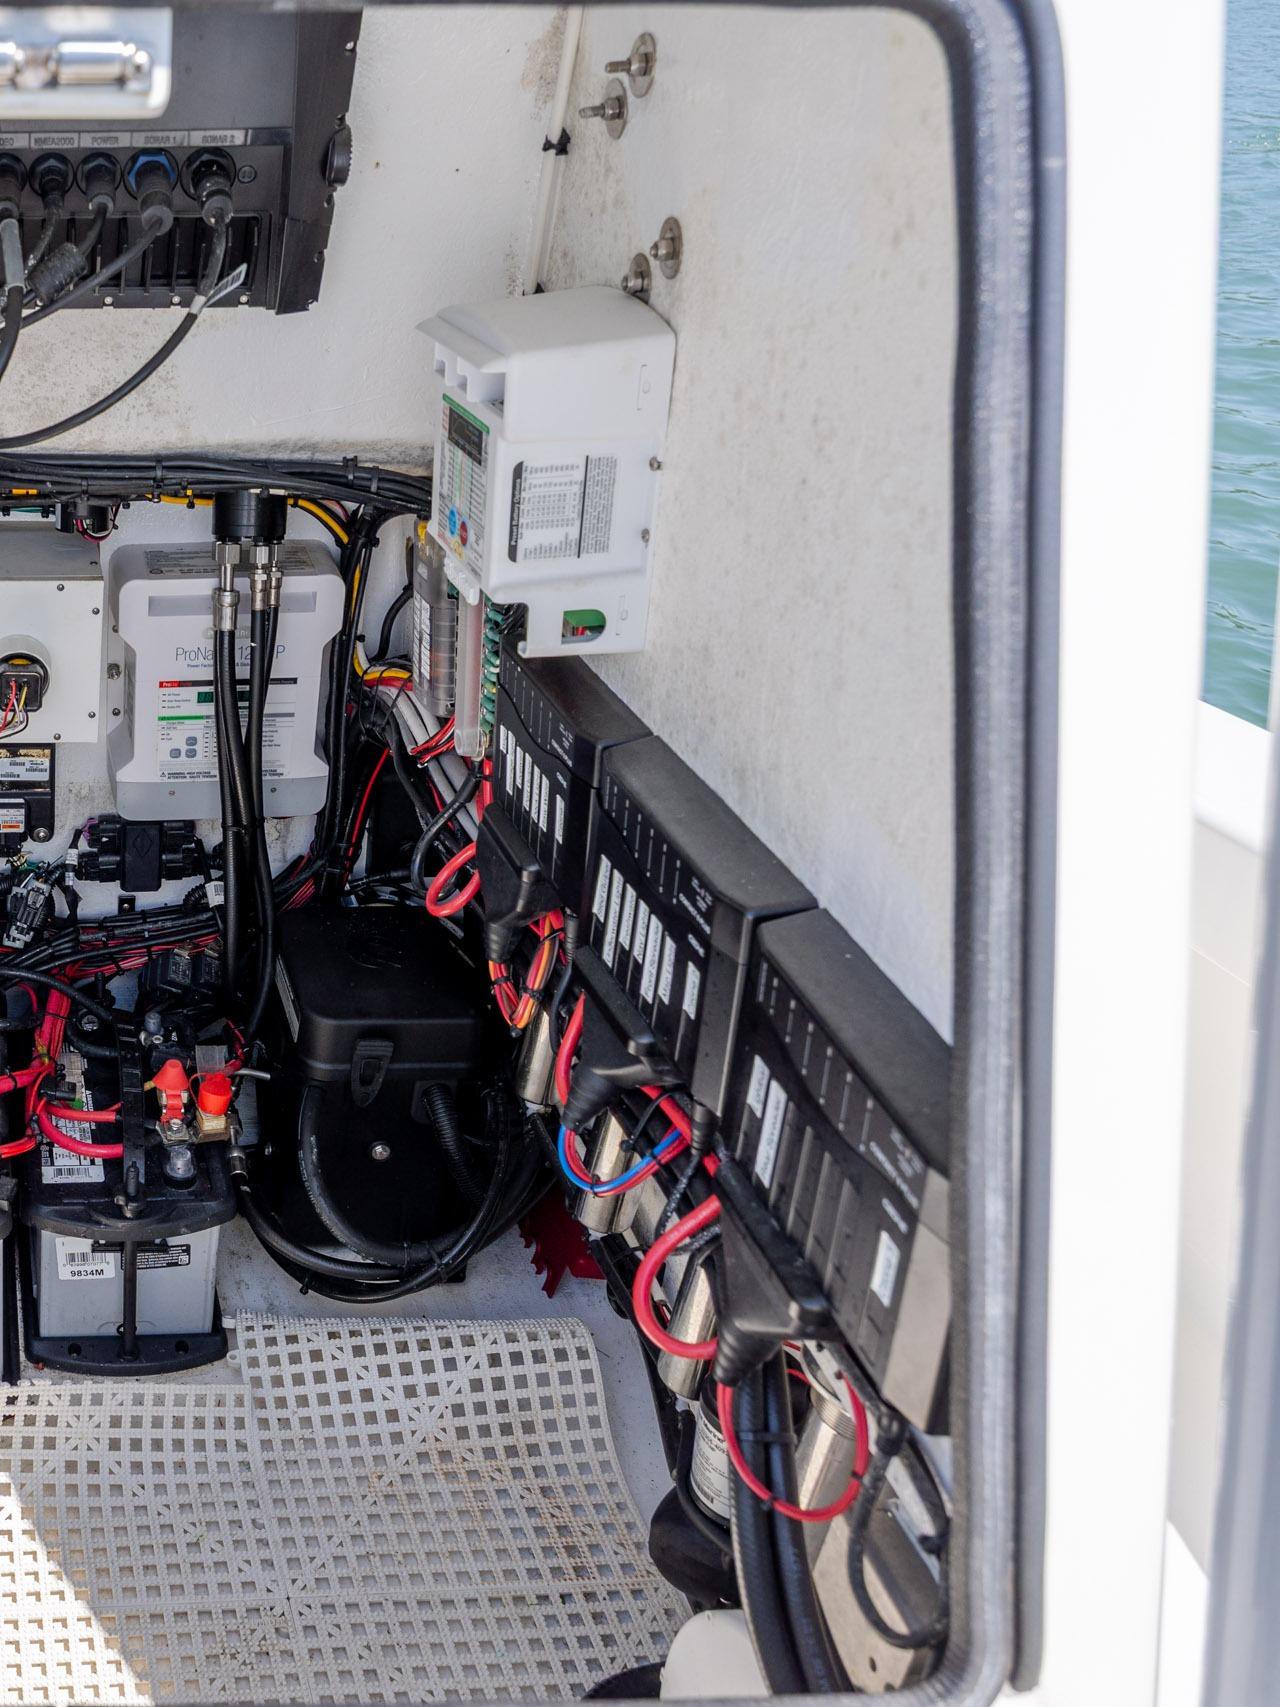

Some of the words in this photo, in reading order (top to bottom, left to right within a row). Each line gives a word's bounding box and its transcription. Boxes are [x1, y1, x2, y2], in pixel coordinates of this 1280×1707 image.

[33, 137, 75, 147] NMEA2000
[91, 136, 119, 146] POWER
[70, 1269, 105, 1278] 9834M
